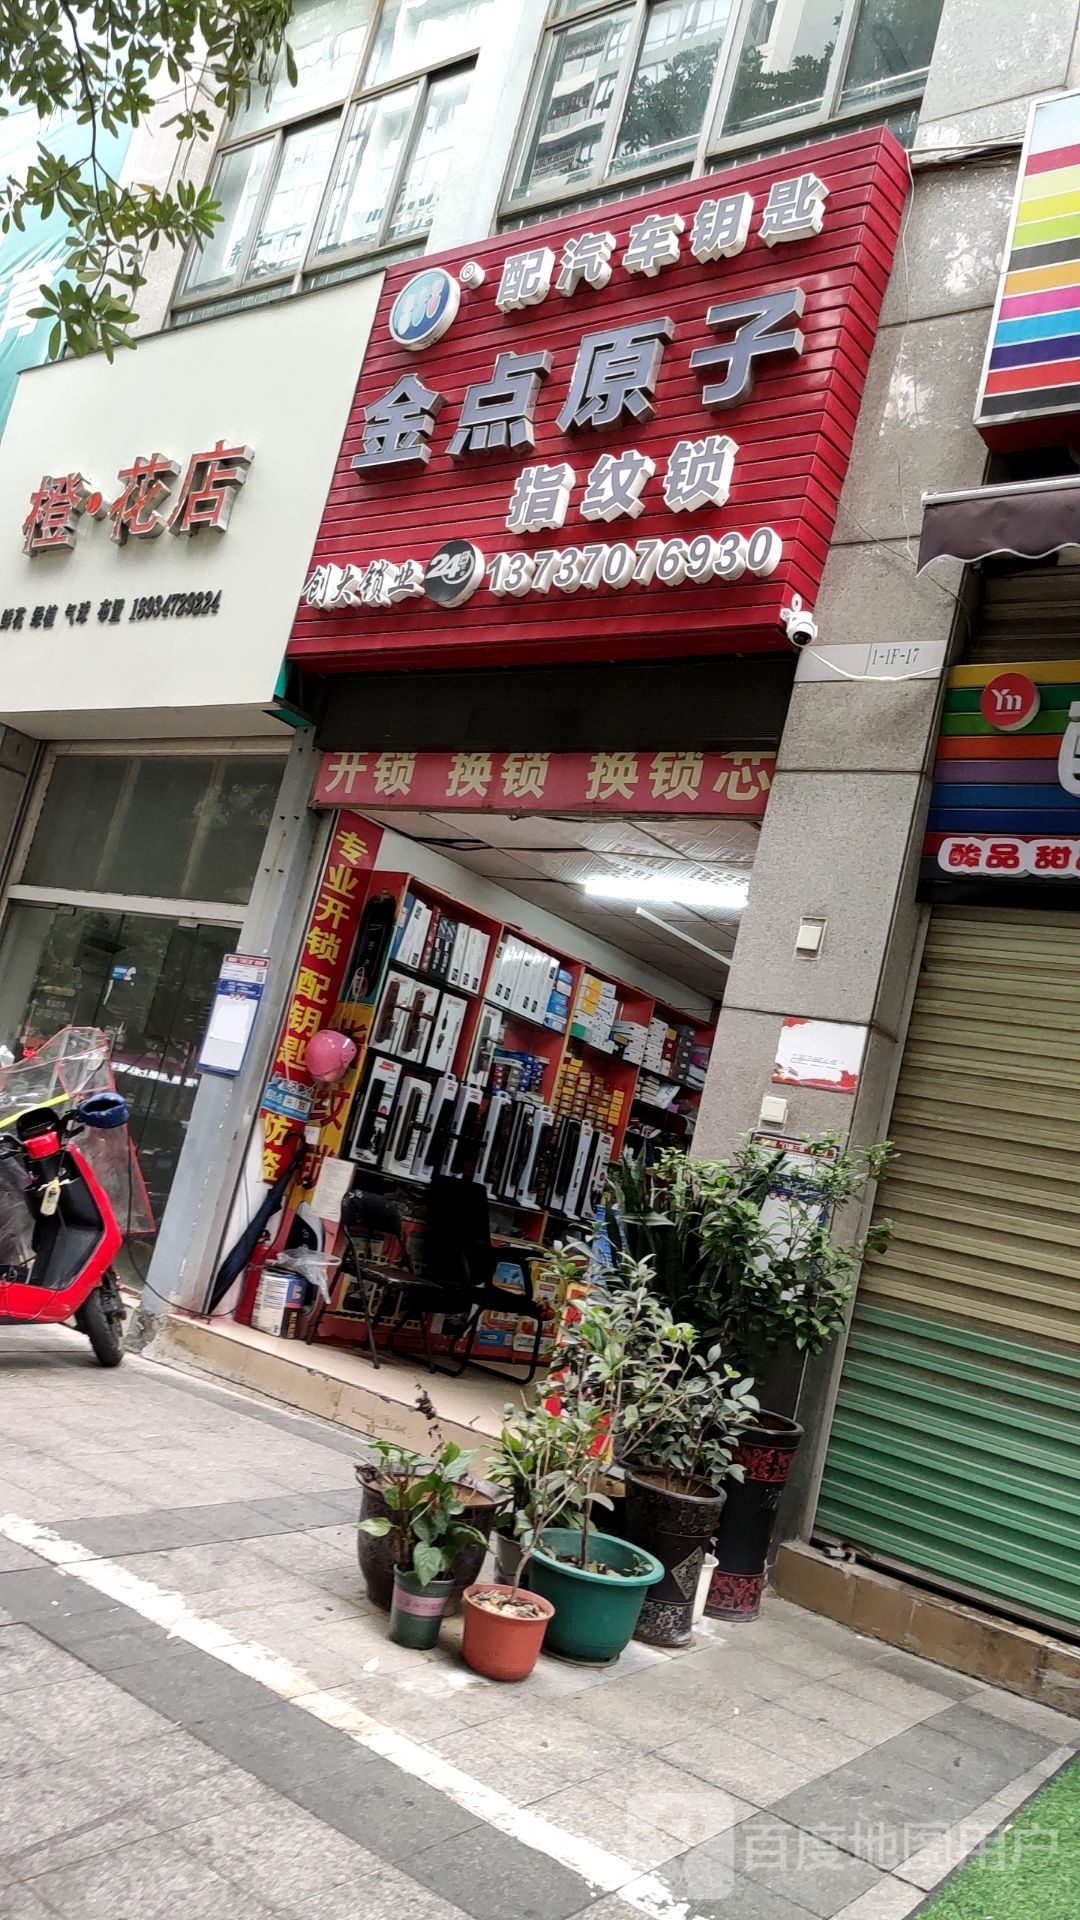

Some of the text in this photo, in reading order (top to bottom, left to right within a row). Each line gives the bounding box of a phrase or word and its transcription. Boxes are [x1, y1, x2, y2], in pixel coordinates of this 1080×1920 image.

[497, 172, 829, 313] 配汽车钥匙
[350, 287, 807, 478] 金点原子
[506, 435, 738, 534] 指纹锁
[302, 559, 425, 611] 创大锁业
[486, 526, 782, 597] 13737076930
[324, 751, 776, 802] 开锁 换锁 换锁芯
[1034, 845, 1080, 870] 甜
